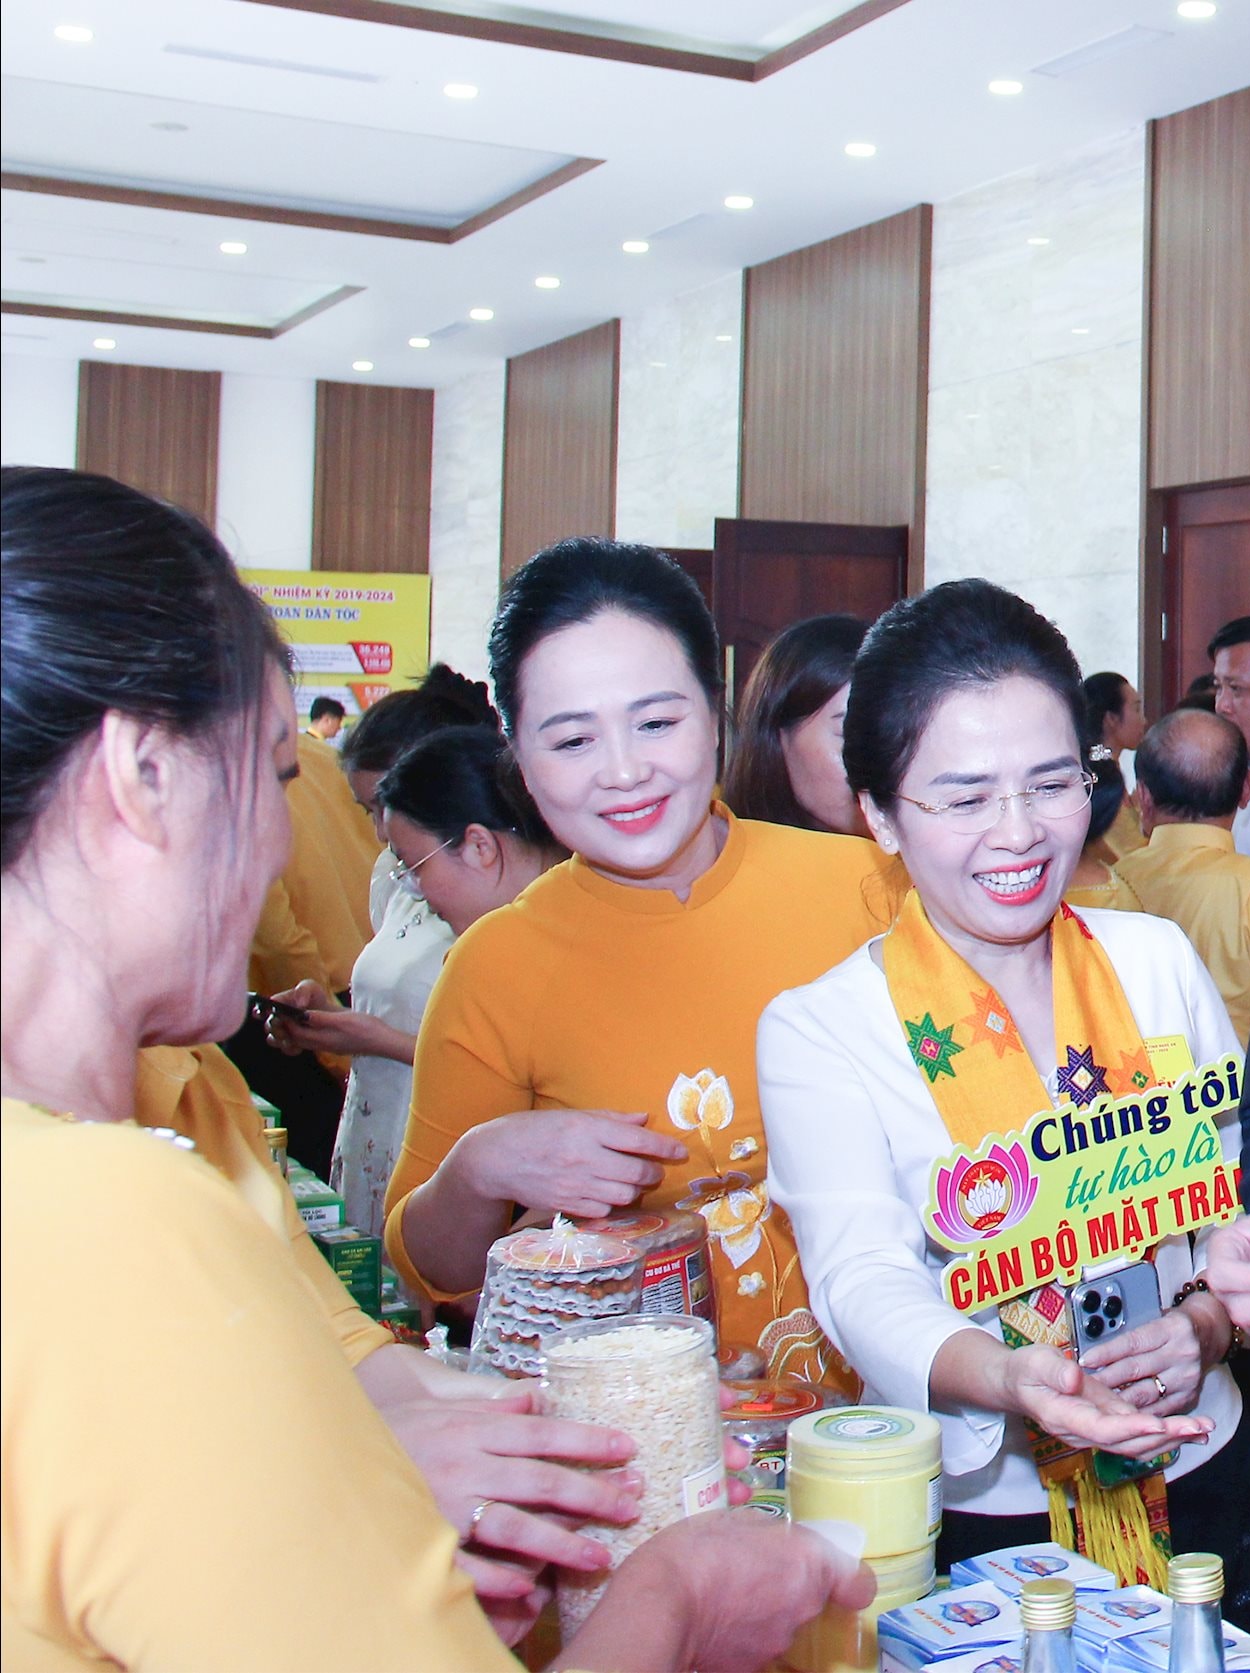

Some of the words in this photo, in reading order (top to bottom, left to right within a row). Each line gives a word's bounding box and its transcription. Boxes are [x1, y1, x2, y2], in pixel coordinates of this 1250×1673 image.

[1031, 1095, 1171, 1162] Chúng
[1180, 1060, 1241, 1115] tôi
[1065, 1166, 1105, 1213] tự
[1108, 1144, 1176, 1195] hào
[1182, 1121, 1219, 1169] là
[950, 1247, 1024, 1311] CÁN
[1031, 1219, 1079, 1277] BỘ
[1086, 1196, 1159, 1258] MẶT
